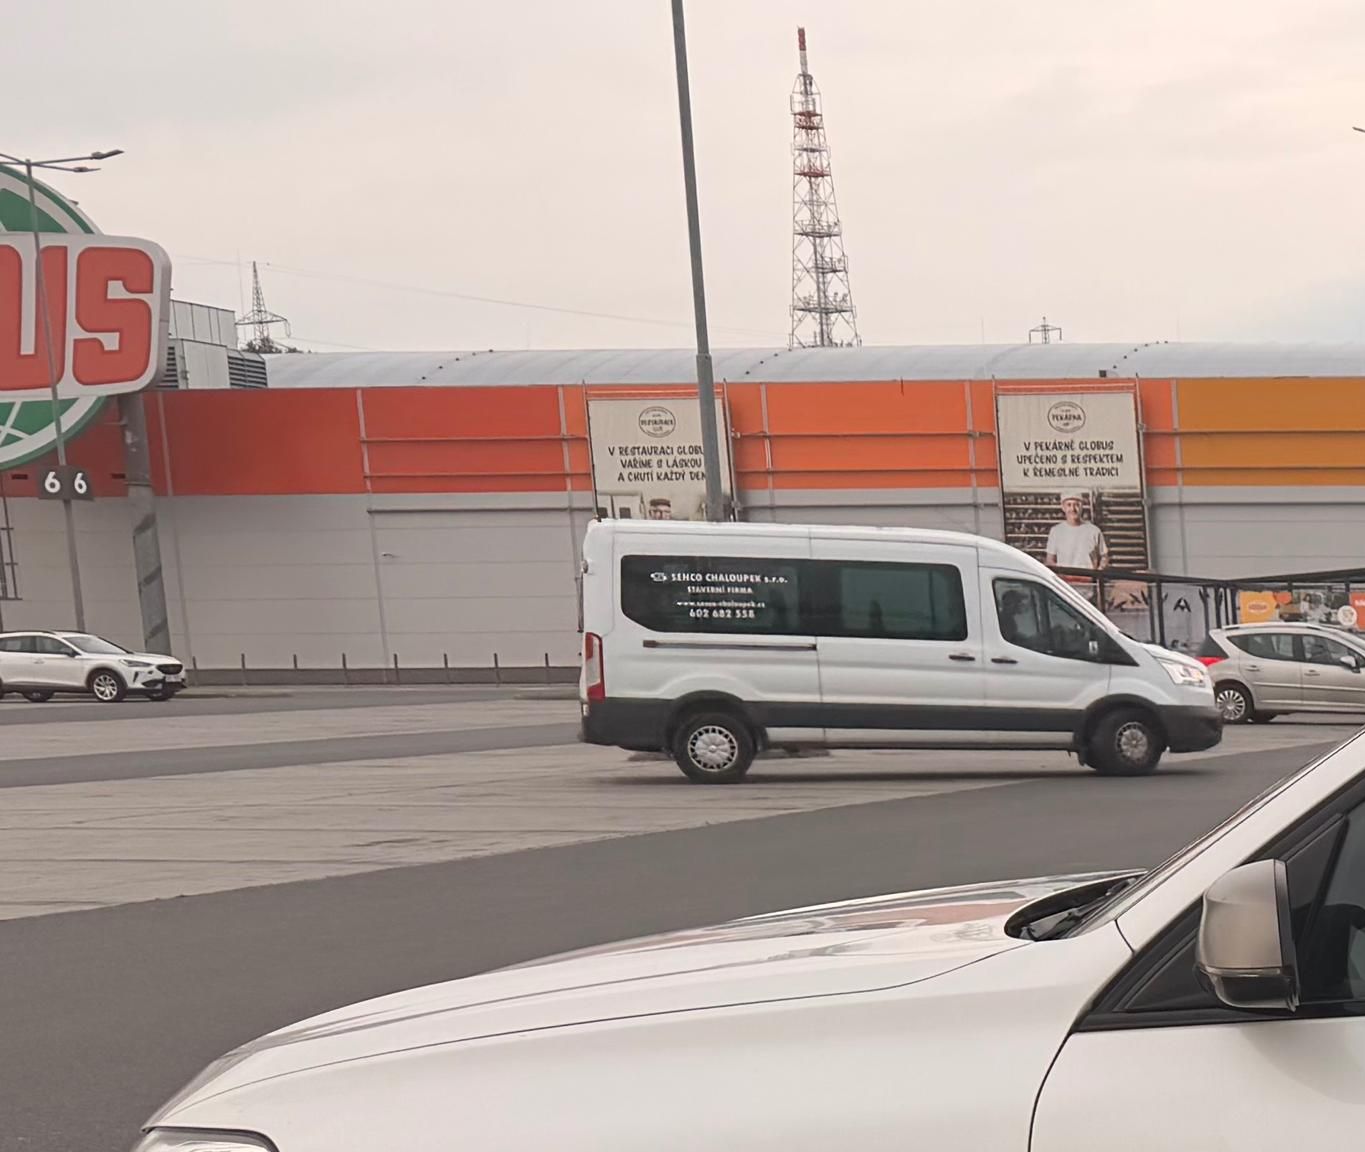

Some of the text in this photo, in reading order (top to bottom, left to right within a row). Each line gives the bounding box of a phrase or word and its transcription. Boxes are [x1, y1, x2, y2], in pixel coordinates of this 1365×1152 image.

[1023, 441, 1031, 451] V
[1078, 440, 1115, 451] GLOBUS
[607, 446, 615, 456] V
[1070, 453, 1124, 464] RESPEKTEM
[617, 472, 625, 482] A
[1023, 467, 1030, 478] K
[44, 470, 87, 494] 6 6
[705, 573, 761, 583] CHALOUPEK
[689, 608, 709, 618] 602
